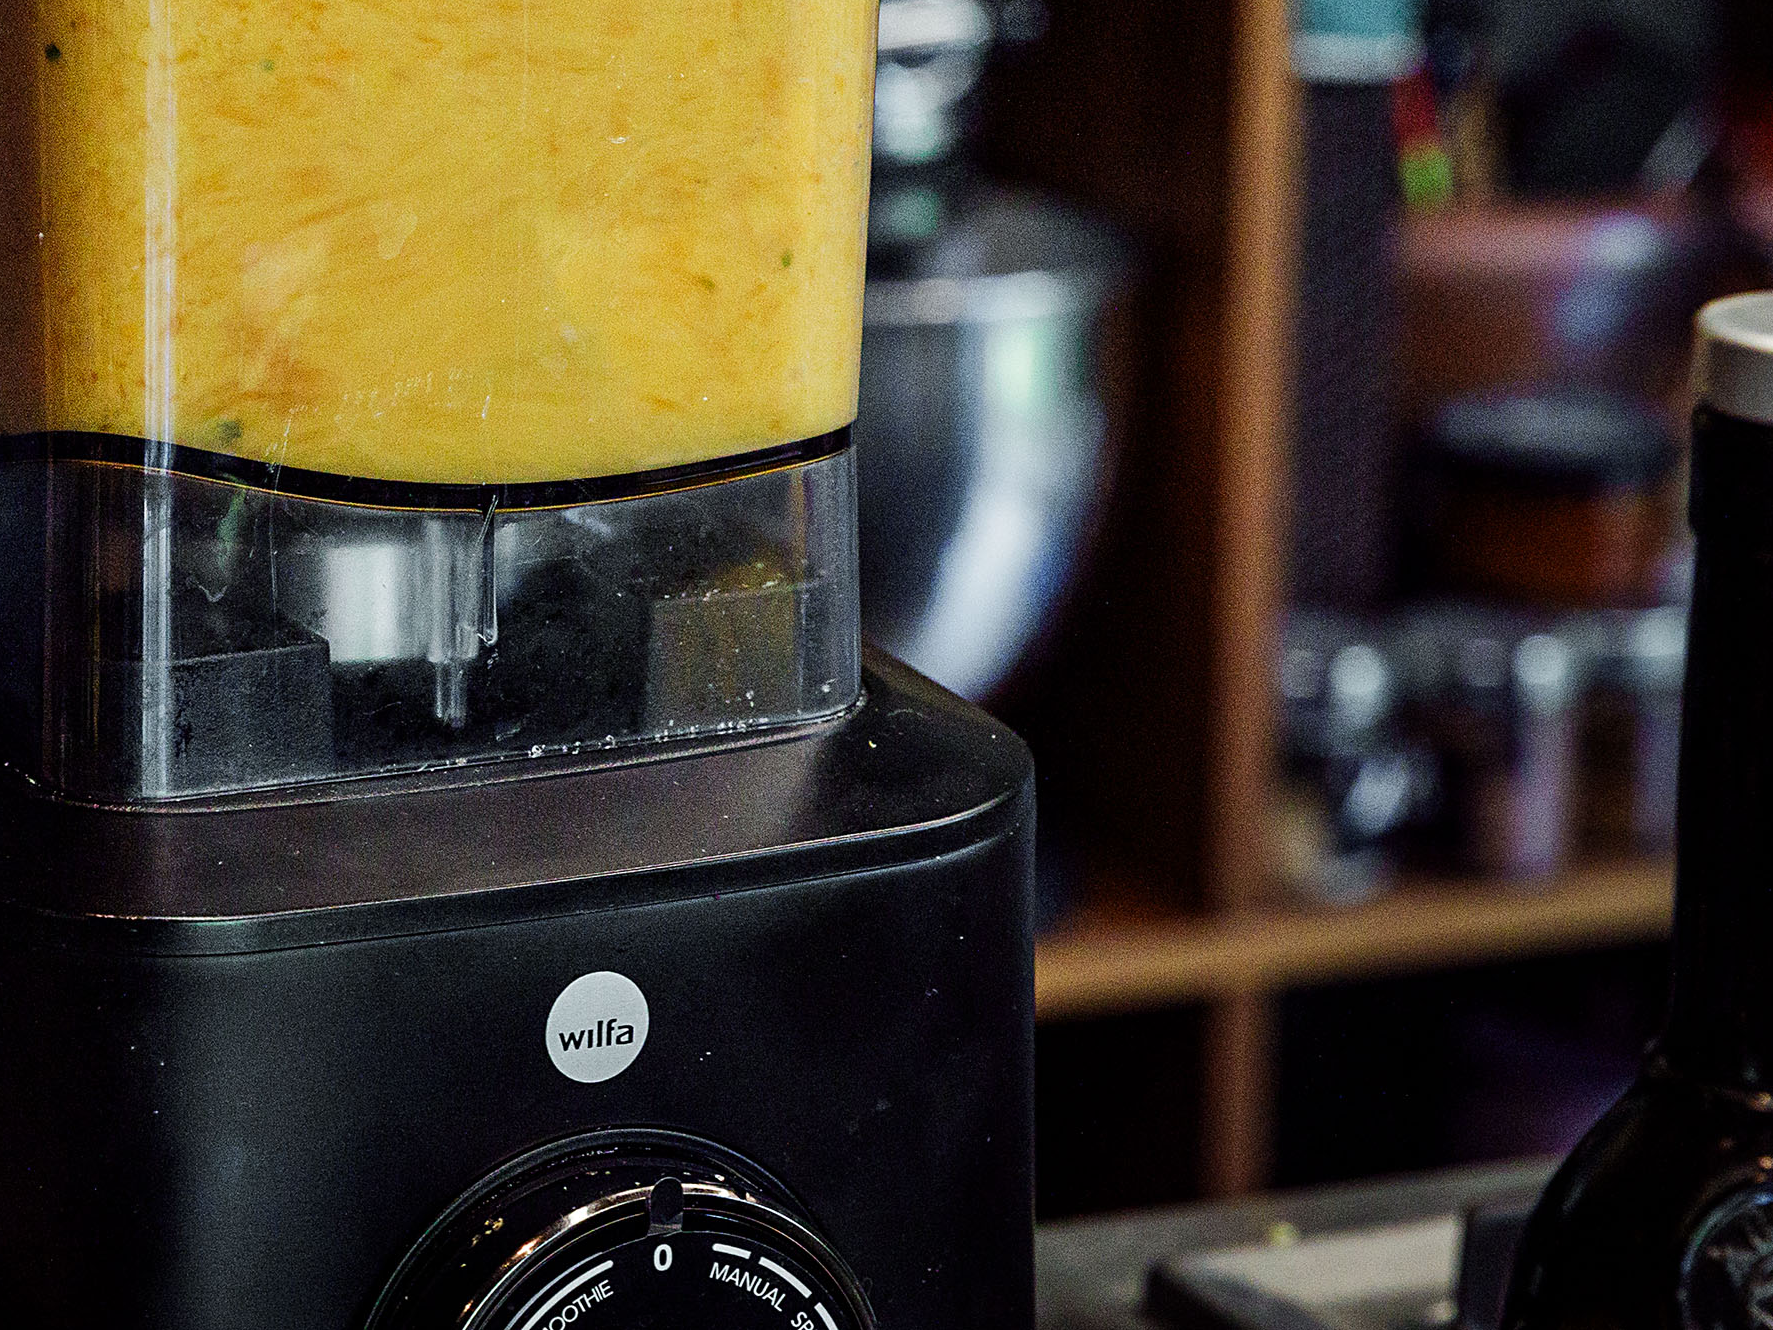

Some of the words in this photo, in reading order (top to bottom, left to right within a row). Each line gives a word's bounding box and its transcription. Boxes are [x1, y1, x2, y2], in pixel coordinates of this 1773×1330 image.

[558, 1018, 634, 1051] wilfa
[653, 1243, 673, 1271] 0
[543, 1279, 614, 1330] OOTHIE
[709, 1262, 786, 1312] MANUAL
